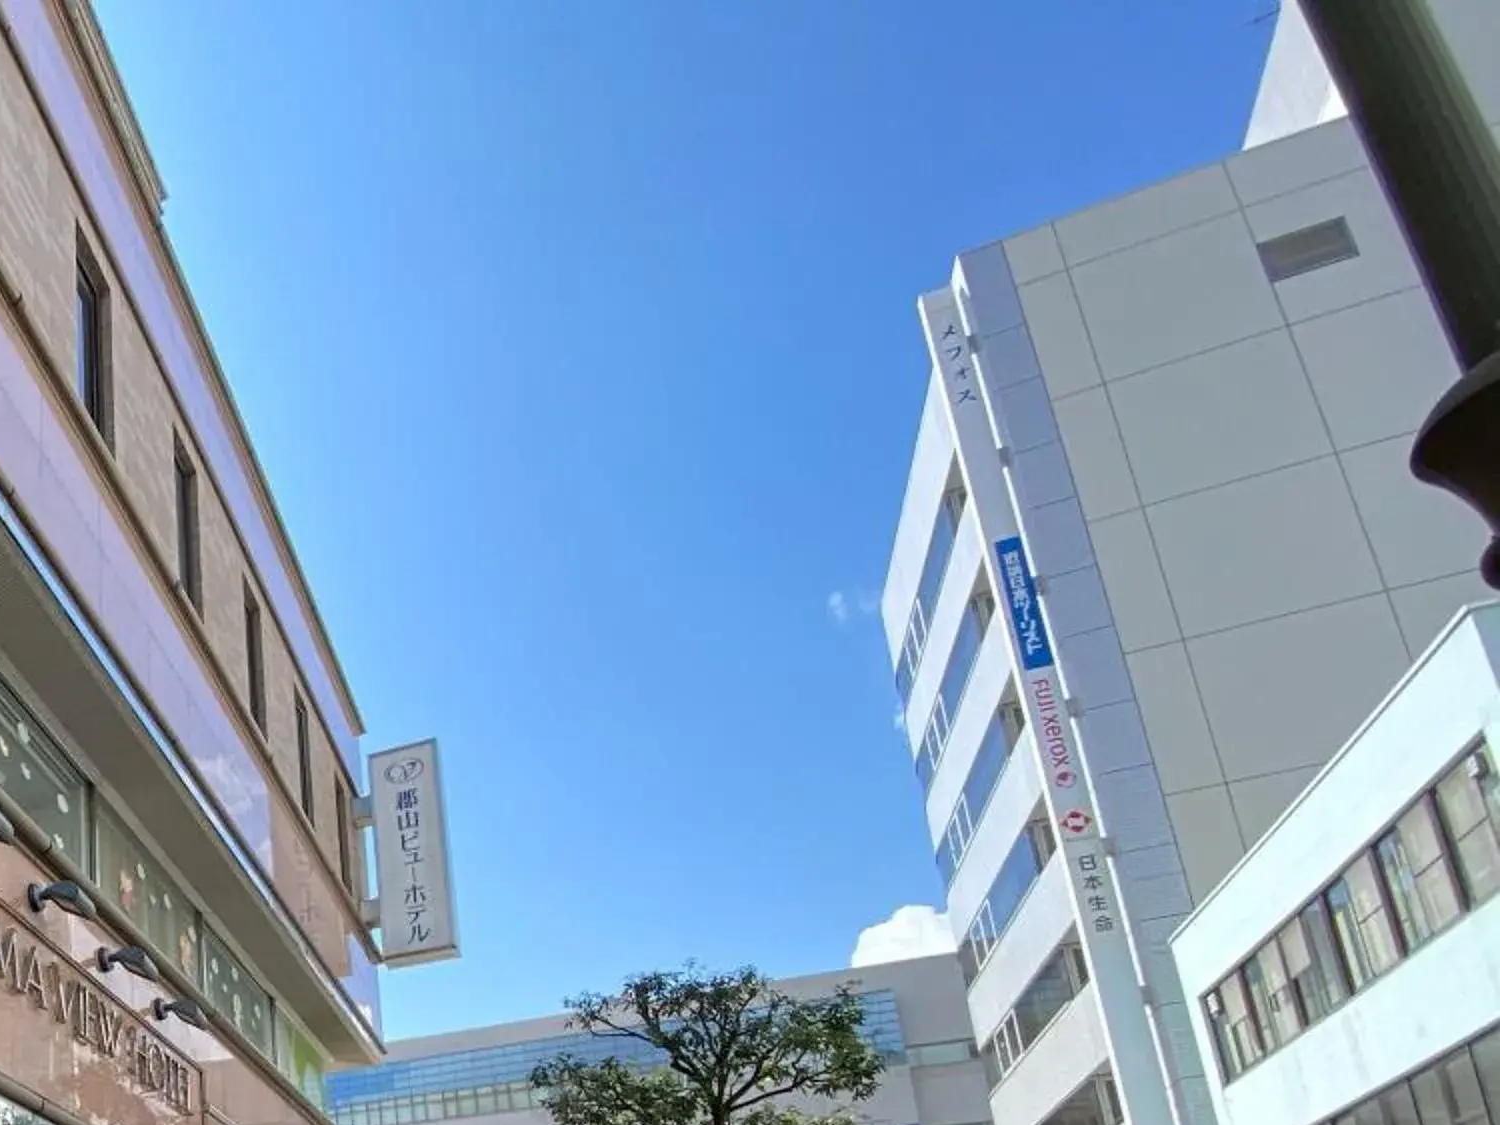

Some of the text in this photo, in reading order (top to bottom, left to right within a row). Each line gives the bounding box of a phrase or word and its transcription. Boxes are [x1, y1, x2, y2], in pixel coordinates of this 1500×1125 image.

[1043, 713, 1070, 768] xerox
[395, 787, 431, 945] 郡山ビューホテル
[1078, 853, 1114, 932] 日本生命
[49, 966, 124, 1058] VIEW
